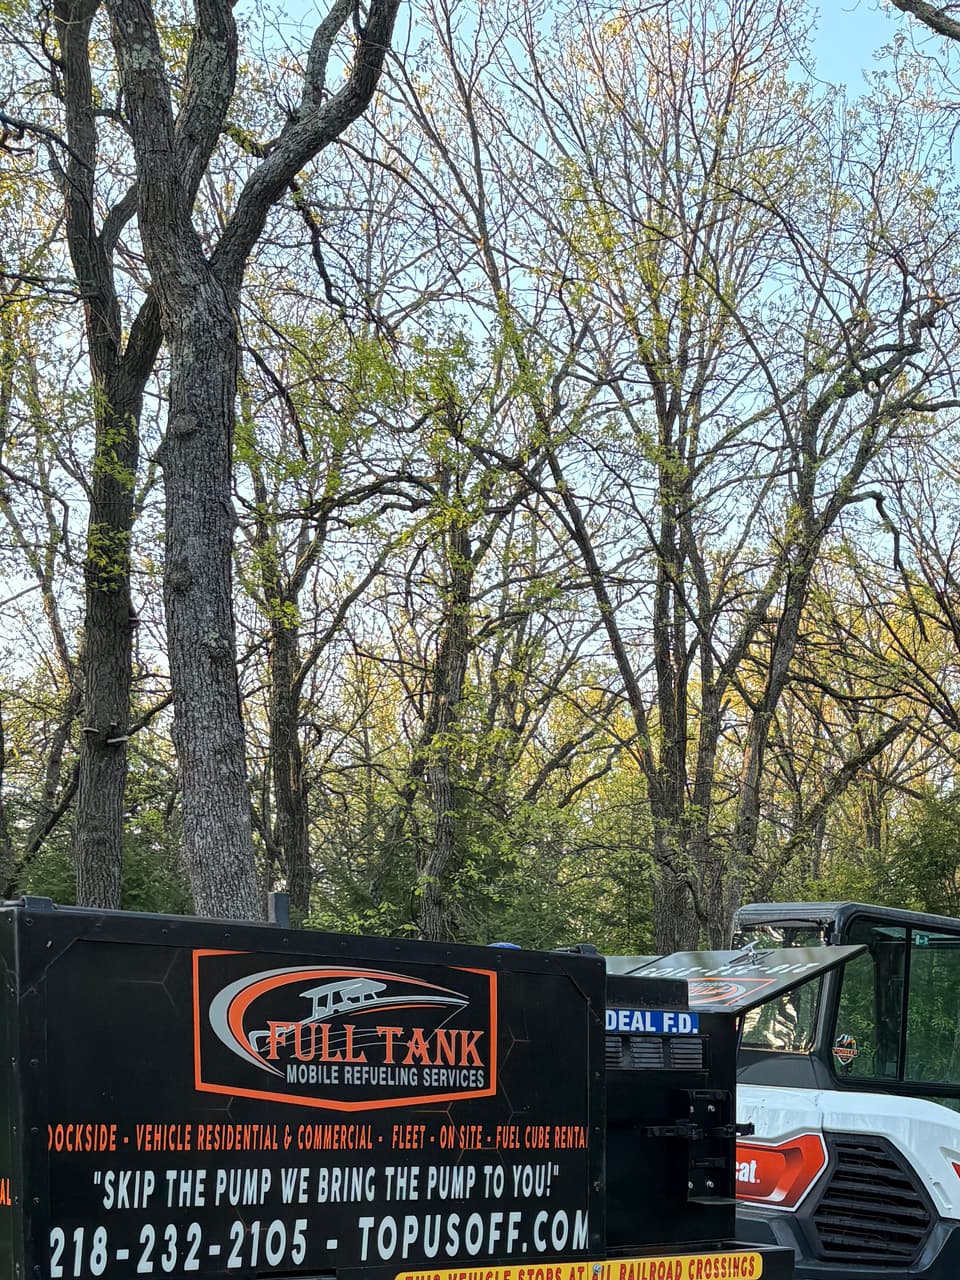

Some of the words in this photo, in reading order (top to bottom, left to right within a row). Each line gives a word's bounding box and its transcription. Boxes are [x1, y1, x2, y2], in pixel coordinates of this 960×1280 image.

[606, 1010, 655, 1031] DEAL
[664, 1009, 698, 1033] F.D.
[266, 1021, 367, 1063] FULL
[376, 1026, 485, 1067] TANK
[287, 1065, 338, 1083] MOBILE
[345, 1066, 417, 1085] REFUELING
[424, 1069, 483, 1087] SERVICES
[137, 1125, 191, 1151] VEHICLE
[198, 1125, 277, 1150] RESIDENTIAL
[284, 1126, 291, 1149] &
[298, 1125, 372, 1149] COMMERCIAL
[393, 1125, 425, 1148] FLEET
[440, 1126, 454, 1148] ON
[460, 1126, 482, 1149] SITE
[496, 1126, 519, 1148] FUEL
[525, 1126, 550, 1148] CUBE
[94, 1171, 154, 1209] "SKIP
[167, 1170, 206, 1207] THE
[216, 1169, 271, 1205] PUMP
[282, 1168, 309, 1203] WE
[318, 1167, 375, 1202] BRING
[386, 1167, 419, 1200] THE
[428, 1166, 475, 1199] PUMP
[484, 1165, 504, 1198] TO
[513, 1162, 558, 1197] YOU!"
[51, 1219, 307, 1277] 218-232-2105
[359, 1210, 588, 1261] TOPUSOFF.COM
[689, 1256, 754, 1280] CROSSINGS
